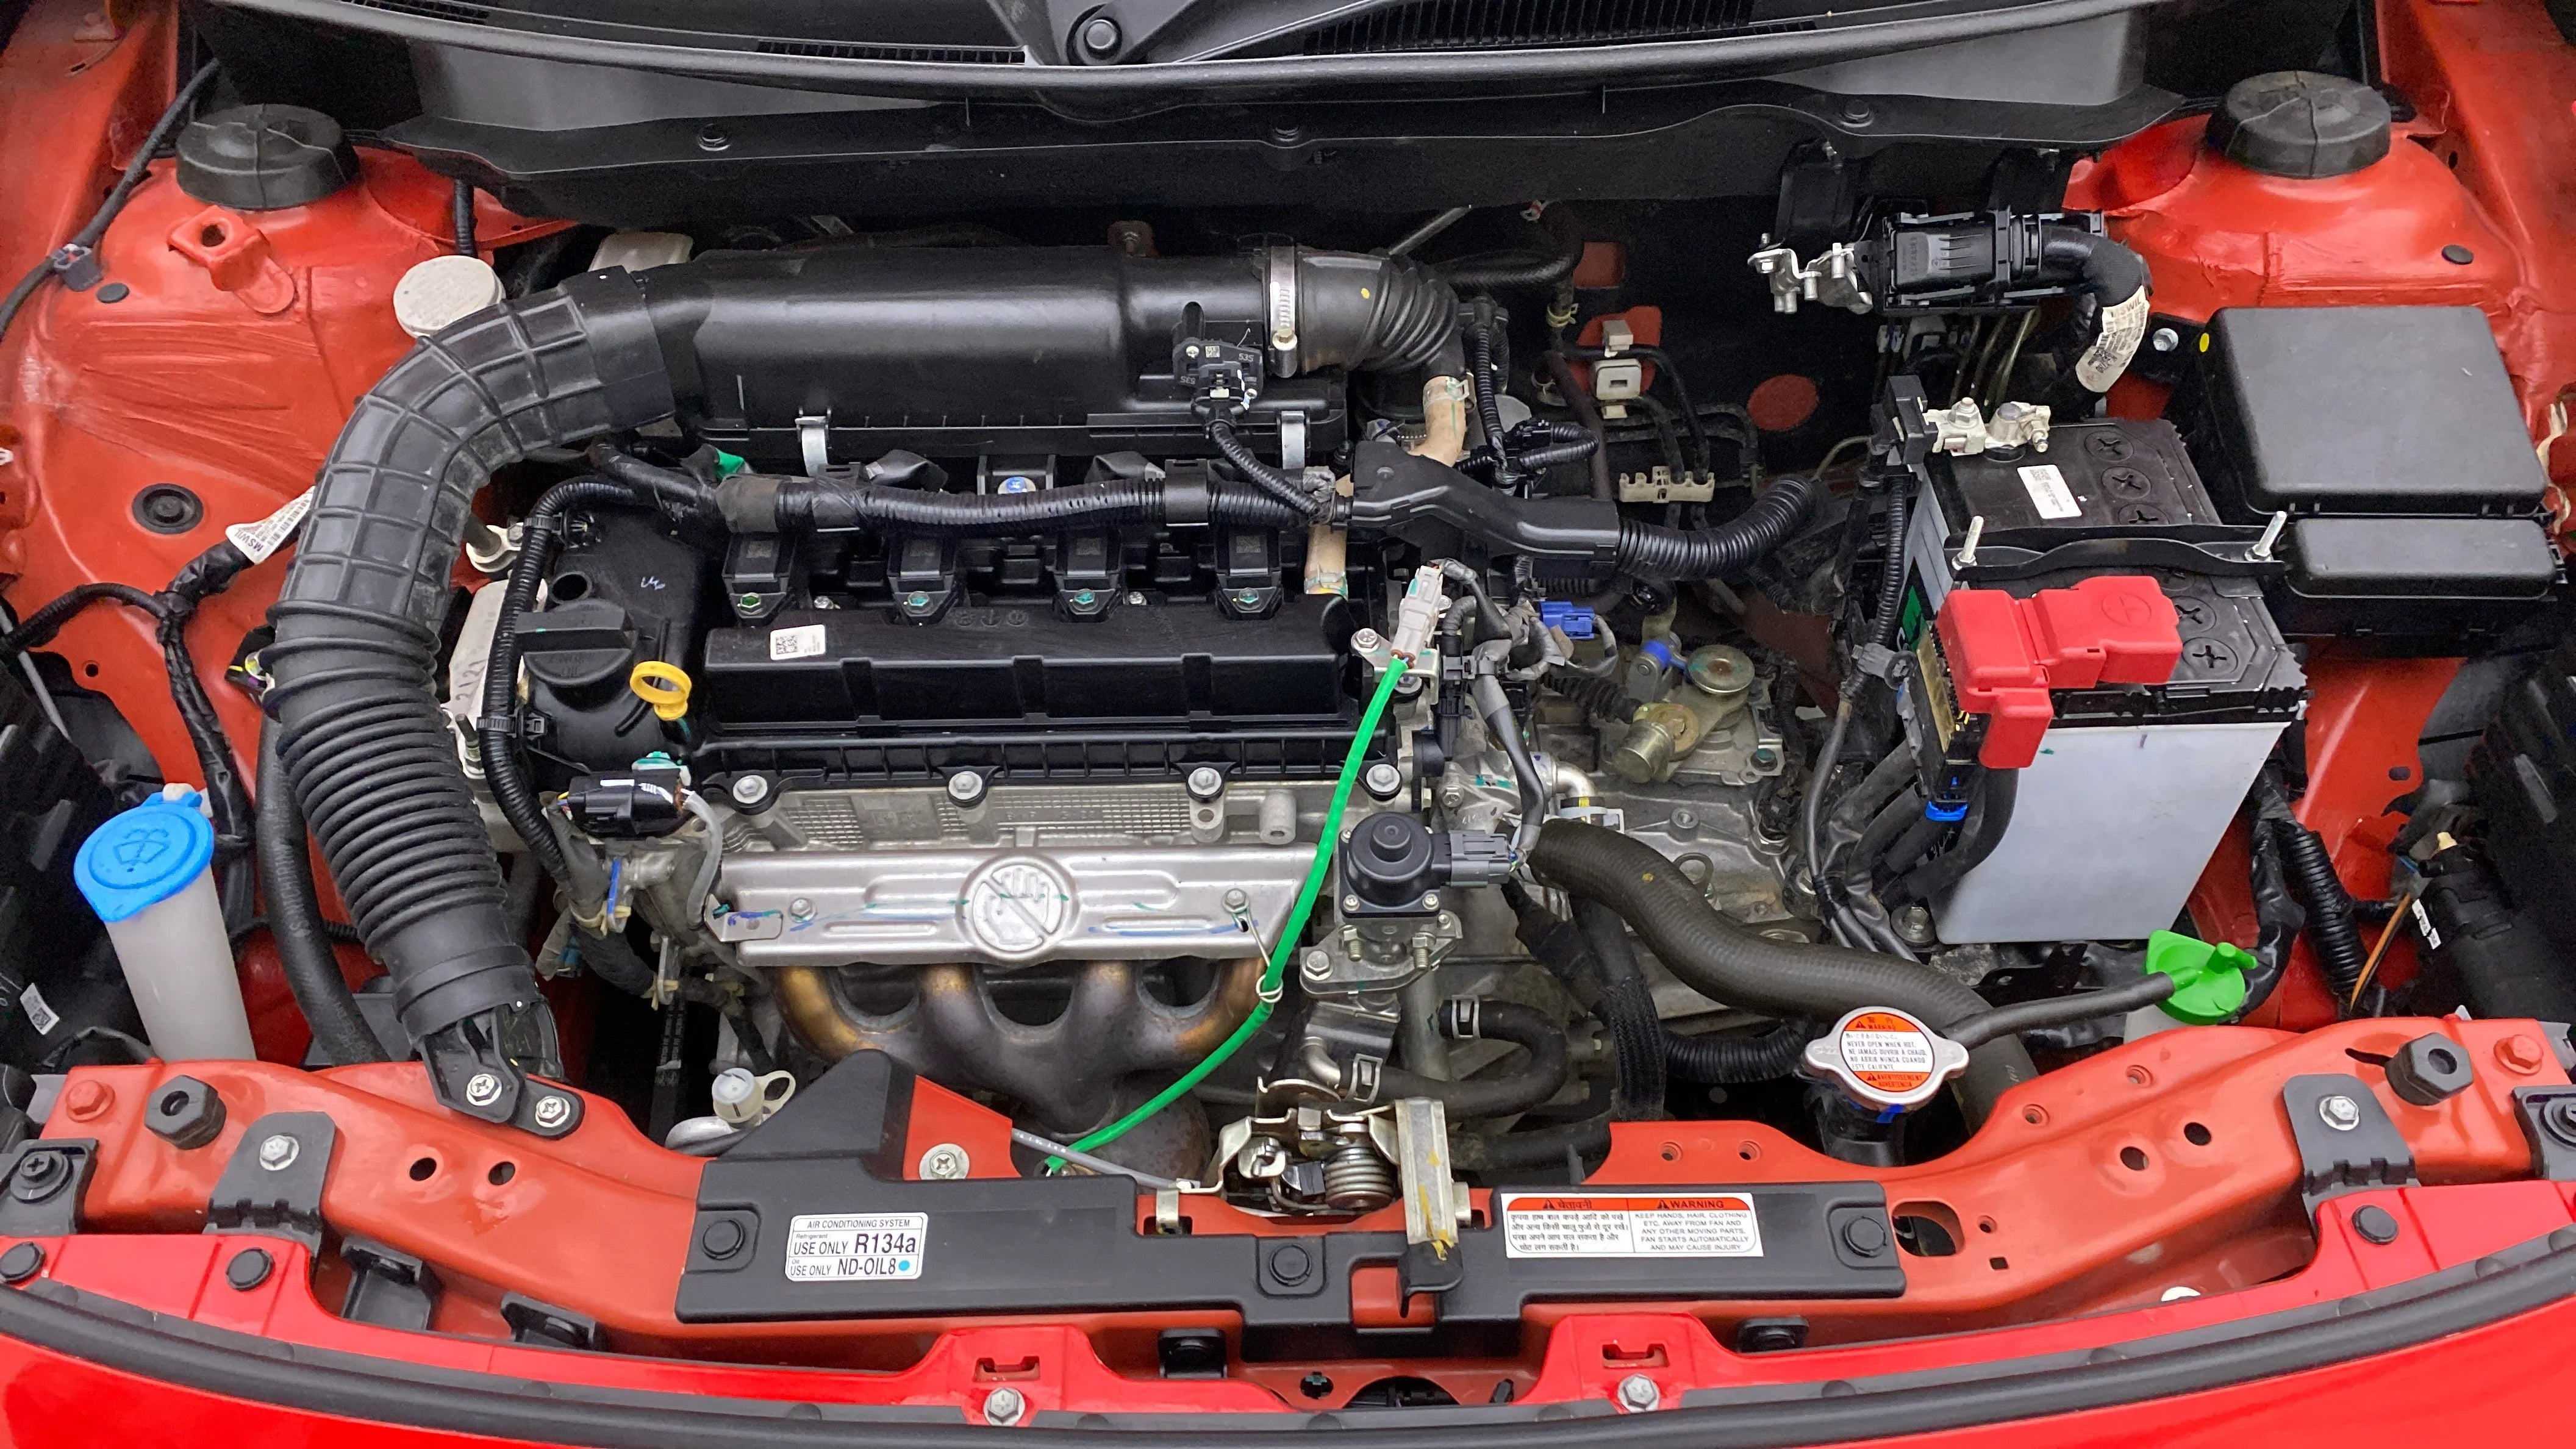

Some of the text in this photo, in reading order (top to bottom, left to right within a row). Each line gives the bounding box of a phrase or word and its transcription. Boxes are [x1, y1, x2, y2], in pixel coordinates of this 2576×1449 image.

[1556, 1198, 1592, 1209] चेतावनी
[1670, 1200, 1724, 1209] WARNING
[822, 1219, 878, 1228] CONDITIONING
[879, 1218, 911, 1227] SYSTEM
[1511, 1214, 1528, 1222] कृपया
[1511, 1222, 1523, 1231] और
[1543, 1222, 1559, 1231] किसी
[1562, 1223, 1576, 1232] चालू
[1594, 1222, 1599, 1231] से
[1601, 1223, 1610, 1232] दूर
[1599, 1232, 1604, 1240] है
[1606, 1232, 1619, 1240] और
[794, 1233, 917, 1255] USE ONLY R134a
[790, 1258, 897, 1276] USE ONLY ND-OIL8
